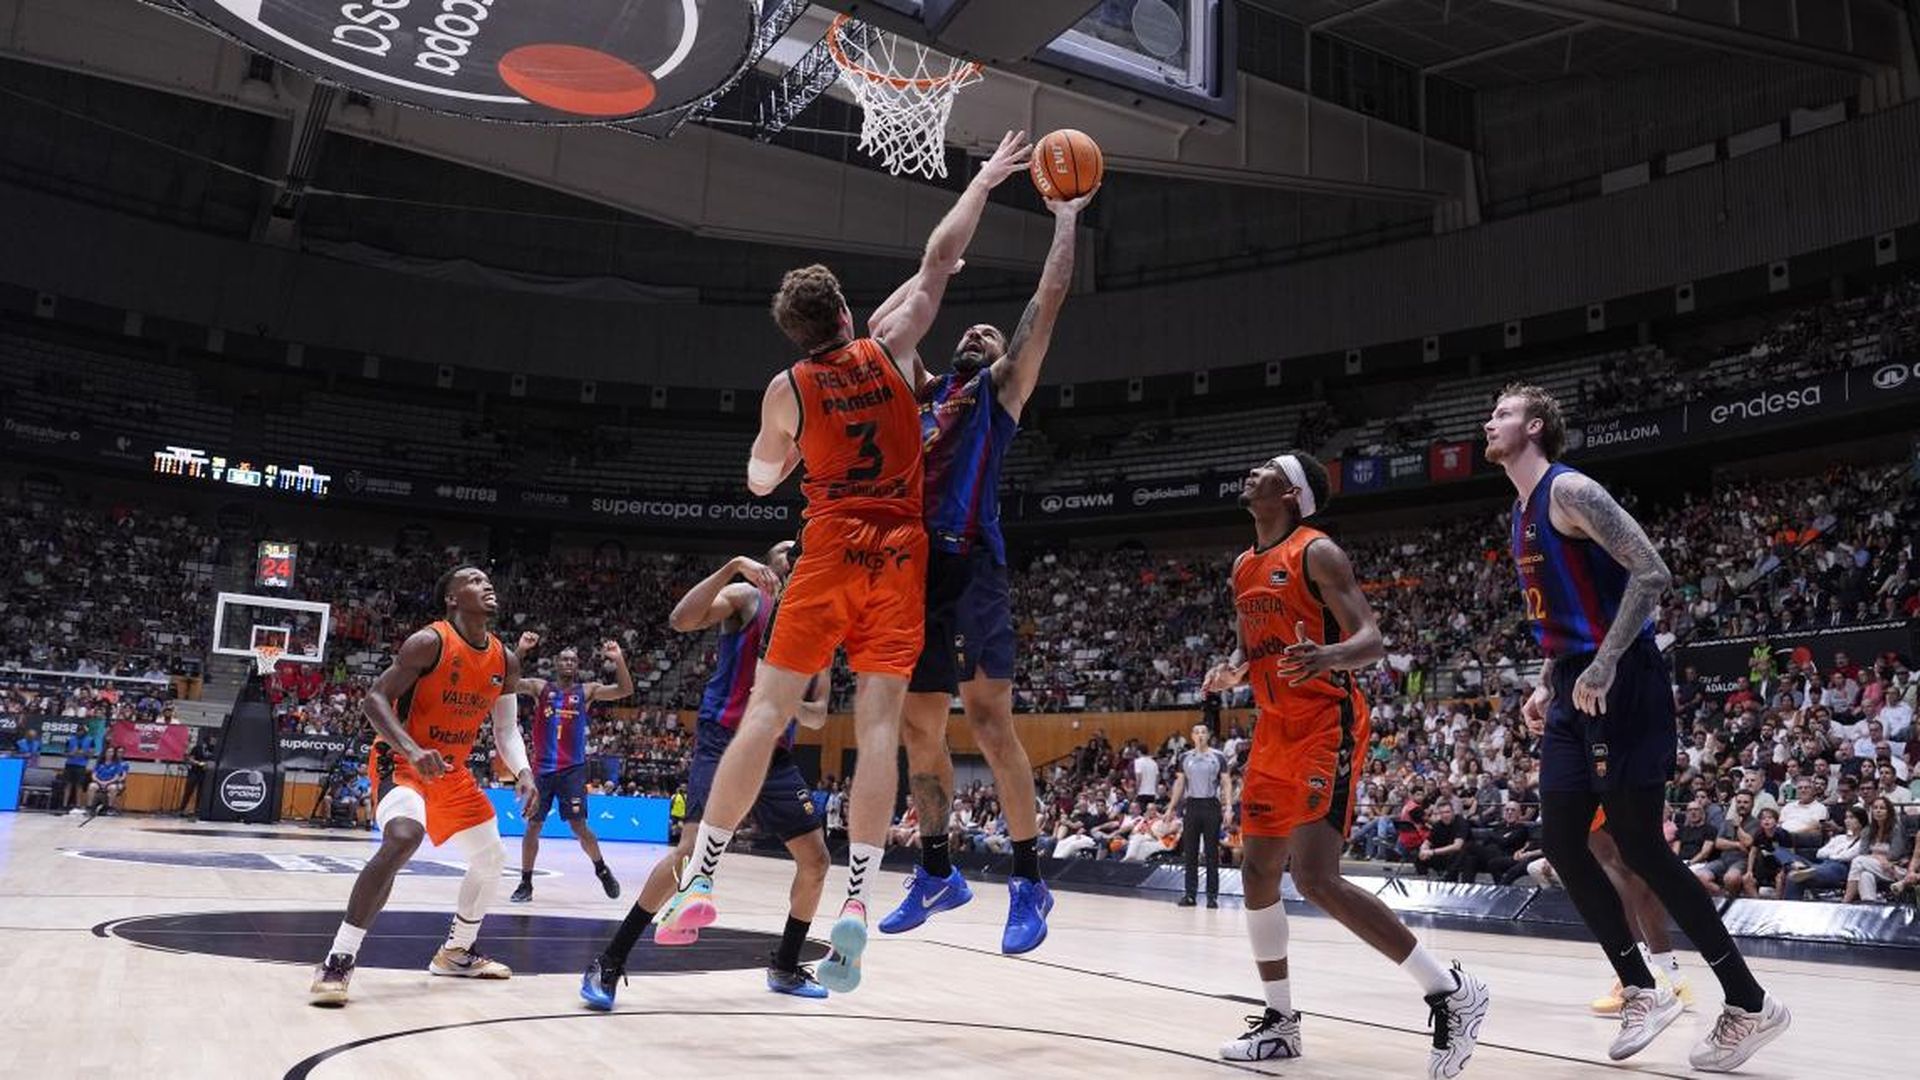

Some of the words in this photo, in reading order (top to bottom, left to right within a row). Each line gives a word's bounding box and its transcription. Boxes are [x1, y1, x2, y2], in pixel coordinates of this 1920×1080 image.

[1710, 383, 1821, 424] endesa
[1586, 423, 1661, 448] BADALONA
[845, 421, 885, 482] 3
[592, 497, 701, 518] supercopa
[708, 502, 789, 520] endesa
[1065, 493, 1114, 509] GWM
[262, 558, 292, 577] 24
[279, 738, 345, 752] supercopa
